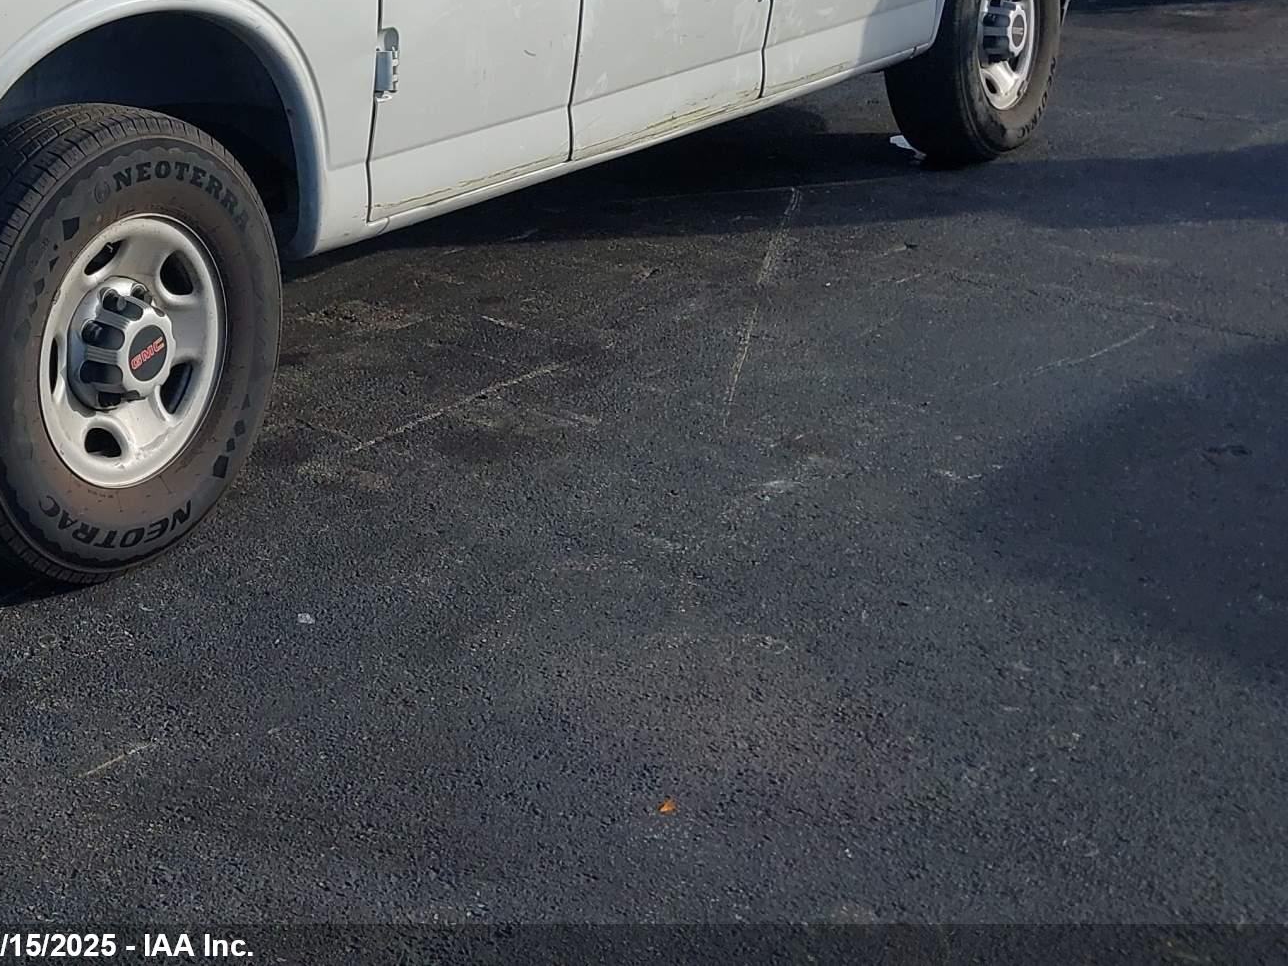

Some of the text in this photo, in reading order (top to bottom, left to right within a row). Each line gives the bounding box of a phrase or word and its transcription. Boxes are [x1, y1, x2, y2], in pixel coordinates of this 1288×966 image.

[112, 160, 250, 232] NEOTERRA
[130, 336, 165, 371] GMC
[38, 494, 192, 549] NEOTRAC
